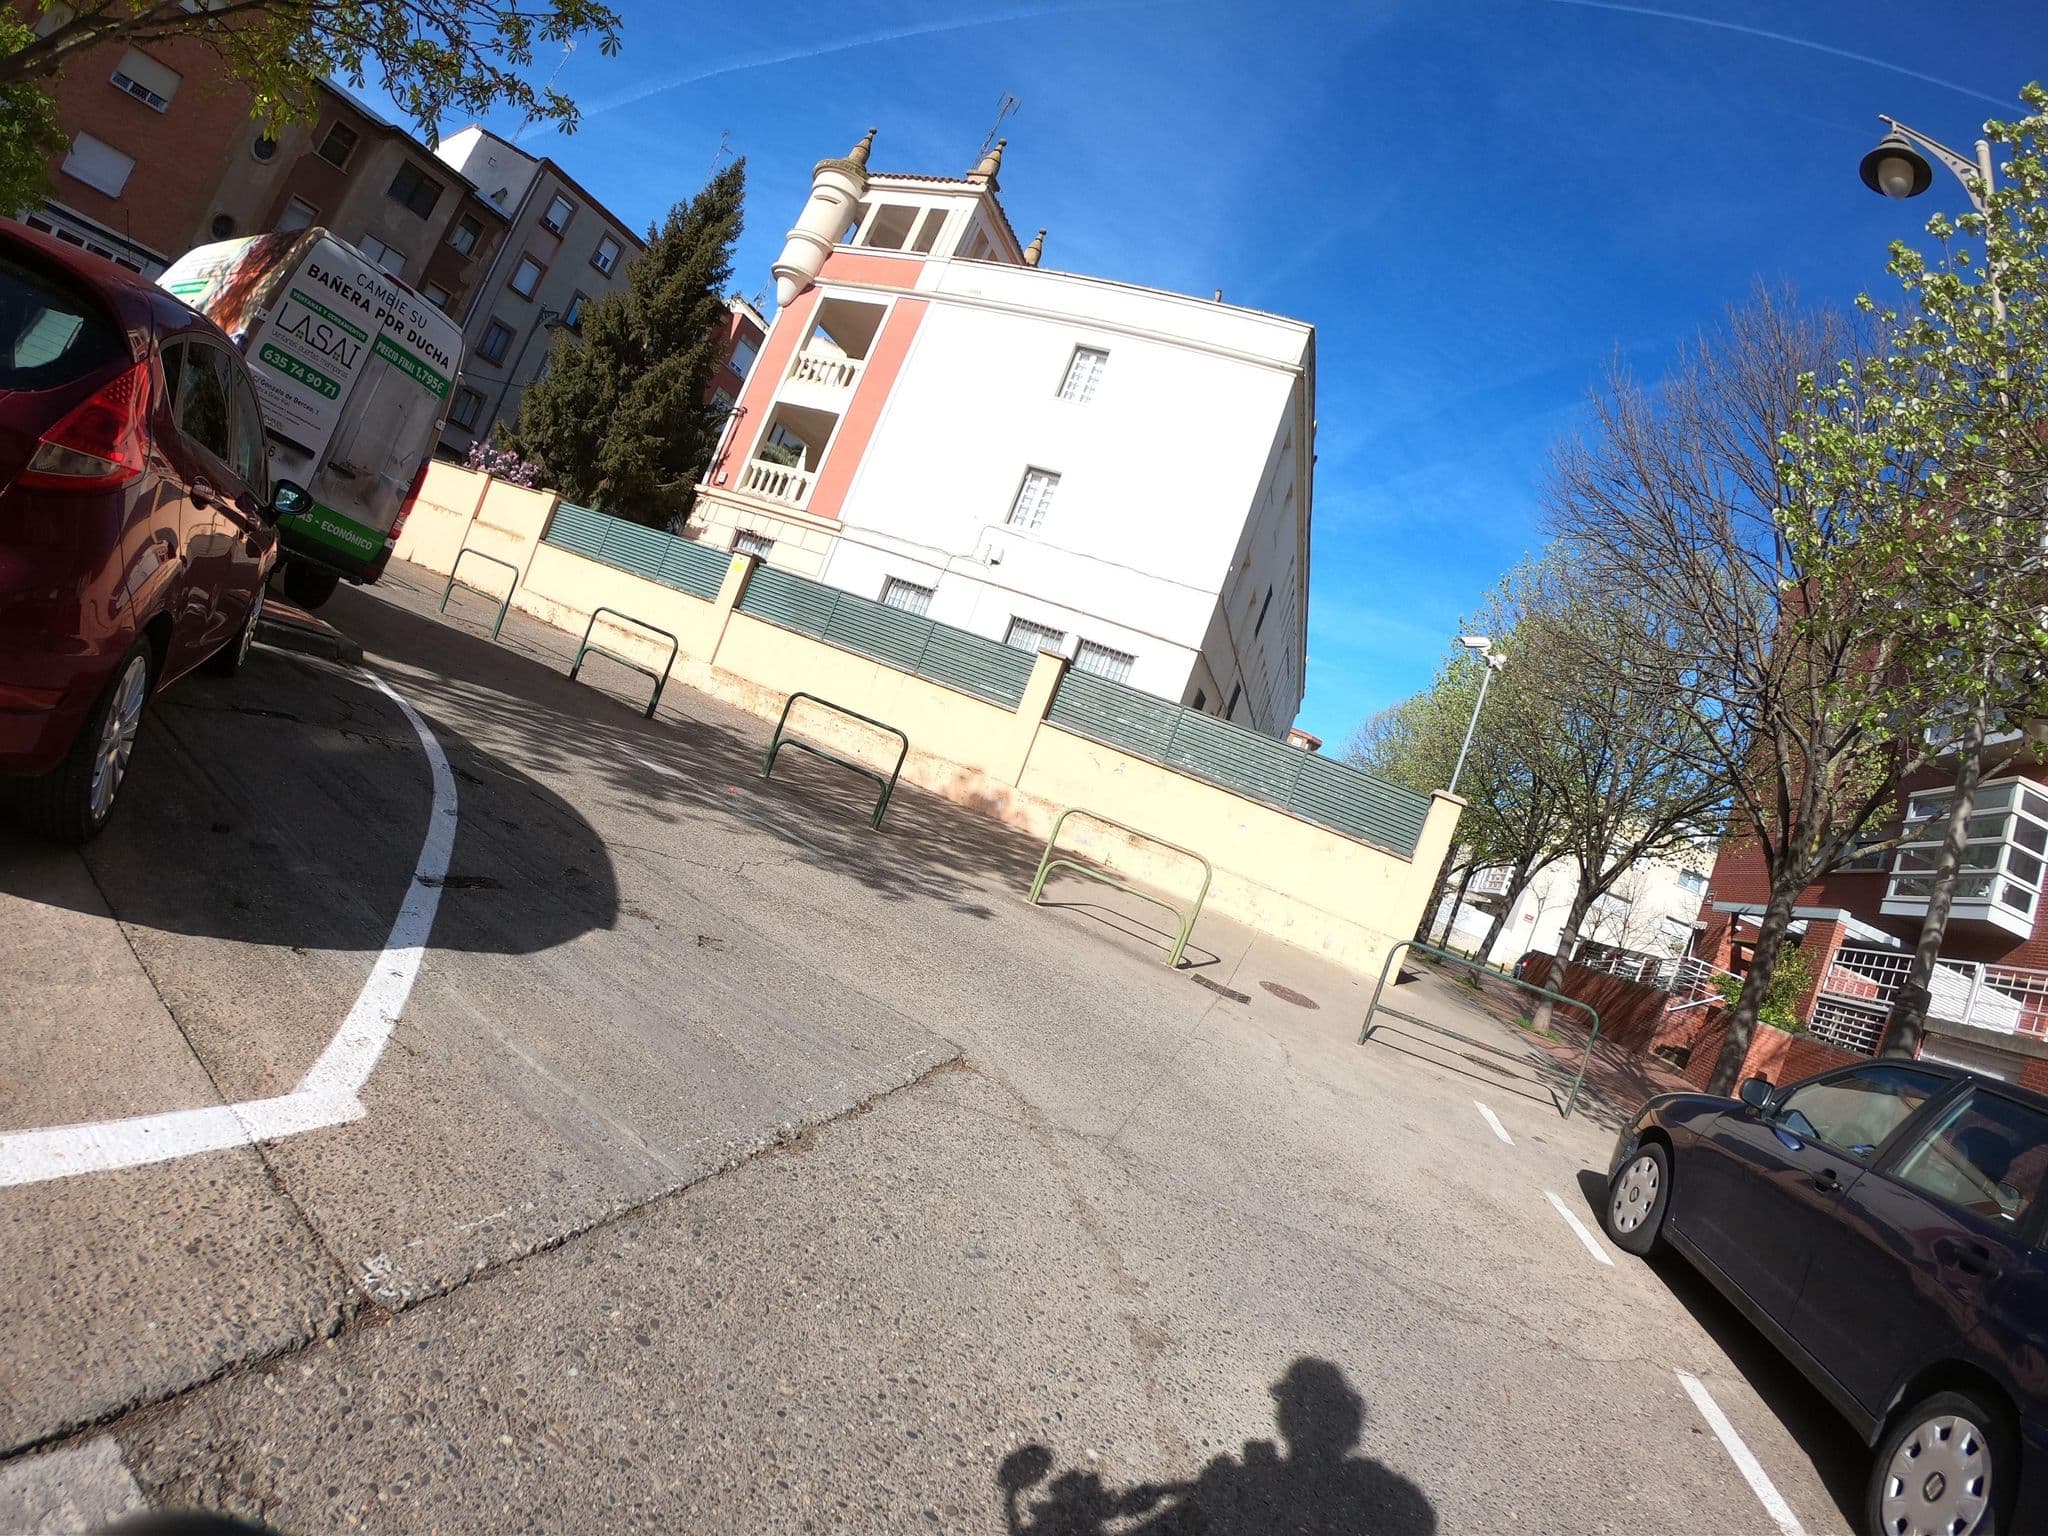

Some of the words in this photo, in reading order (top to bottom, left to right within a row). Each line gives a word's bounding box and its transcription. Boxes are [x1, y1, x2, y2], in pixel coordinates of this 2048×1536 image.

[307, 263, 370, 312] BAÑERA
[375, 307, 405, 335] POR
[406, 329, 449, 370] DUCHA
[357, 273, 408, 315] CAMBIE
[409, 310, 428, 329] SU
[275, 302, 361, 369] LASAI
[264, 350, 289, 369] 635
[289, 363, 305, 378] 74
[306, 373, 322, 388] 90
[324, 383, 338, 397] 71
[376, 341, 399, 362] PRECIO
[416, 366, 445, 394] 1.795€
[285, 392, 292, 400] de
[320, 520, 373, 551] ECONÓMICO
